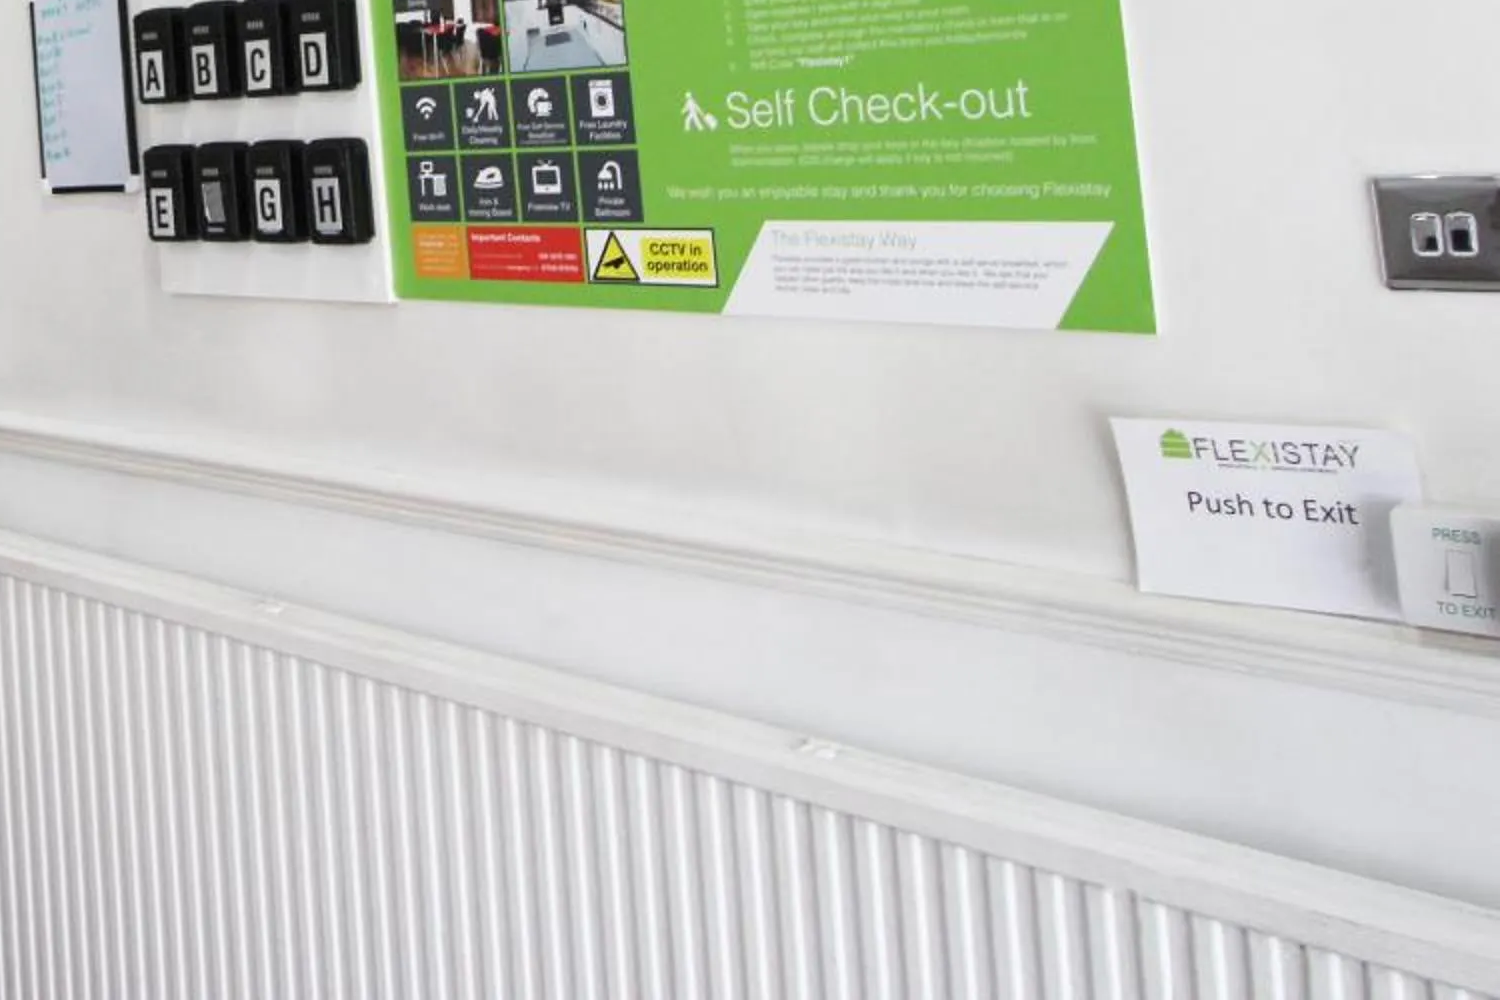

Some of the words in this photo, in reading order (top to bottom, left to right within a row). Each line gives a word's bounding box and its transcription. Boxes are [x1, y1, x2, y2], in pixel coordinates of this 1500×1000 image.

[145, 58, 161, 92] A
[195, 52, 211, 87] B
[250, 48, 266, 83] C
[304, 41, 322, 77] D
[726, 88, 796, 129] Self
[807, 79, 1033, 126] Check-out
[156, 196, 169, 228] E
[260, 187, 276, 221] G
[317, 186, 336, 223] H
[647, 258, 709, 273] operation
[649, 243, 686, 257] CCTV
[688, 242, 702, 256] in
[1193, 436, 1361, 468] FLEXISTAY
[1188, 491, 1254, 518] Push
[1265, 497, 1293, 520] to
[1303, 498, 1360, 525] Exit
[1432, 527, 1481, 545] PRESS
[1436, 600, 1458, 615] TO
[1462, 604, 1497, 620] EXIT
